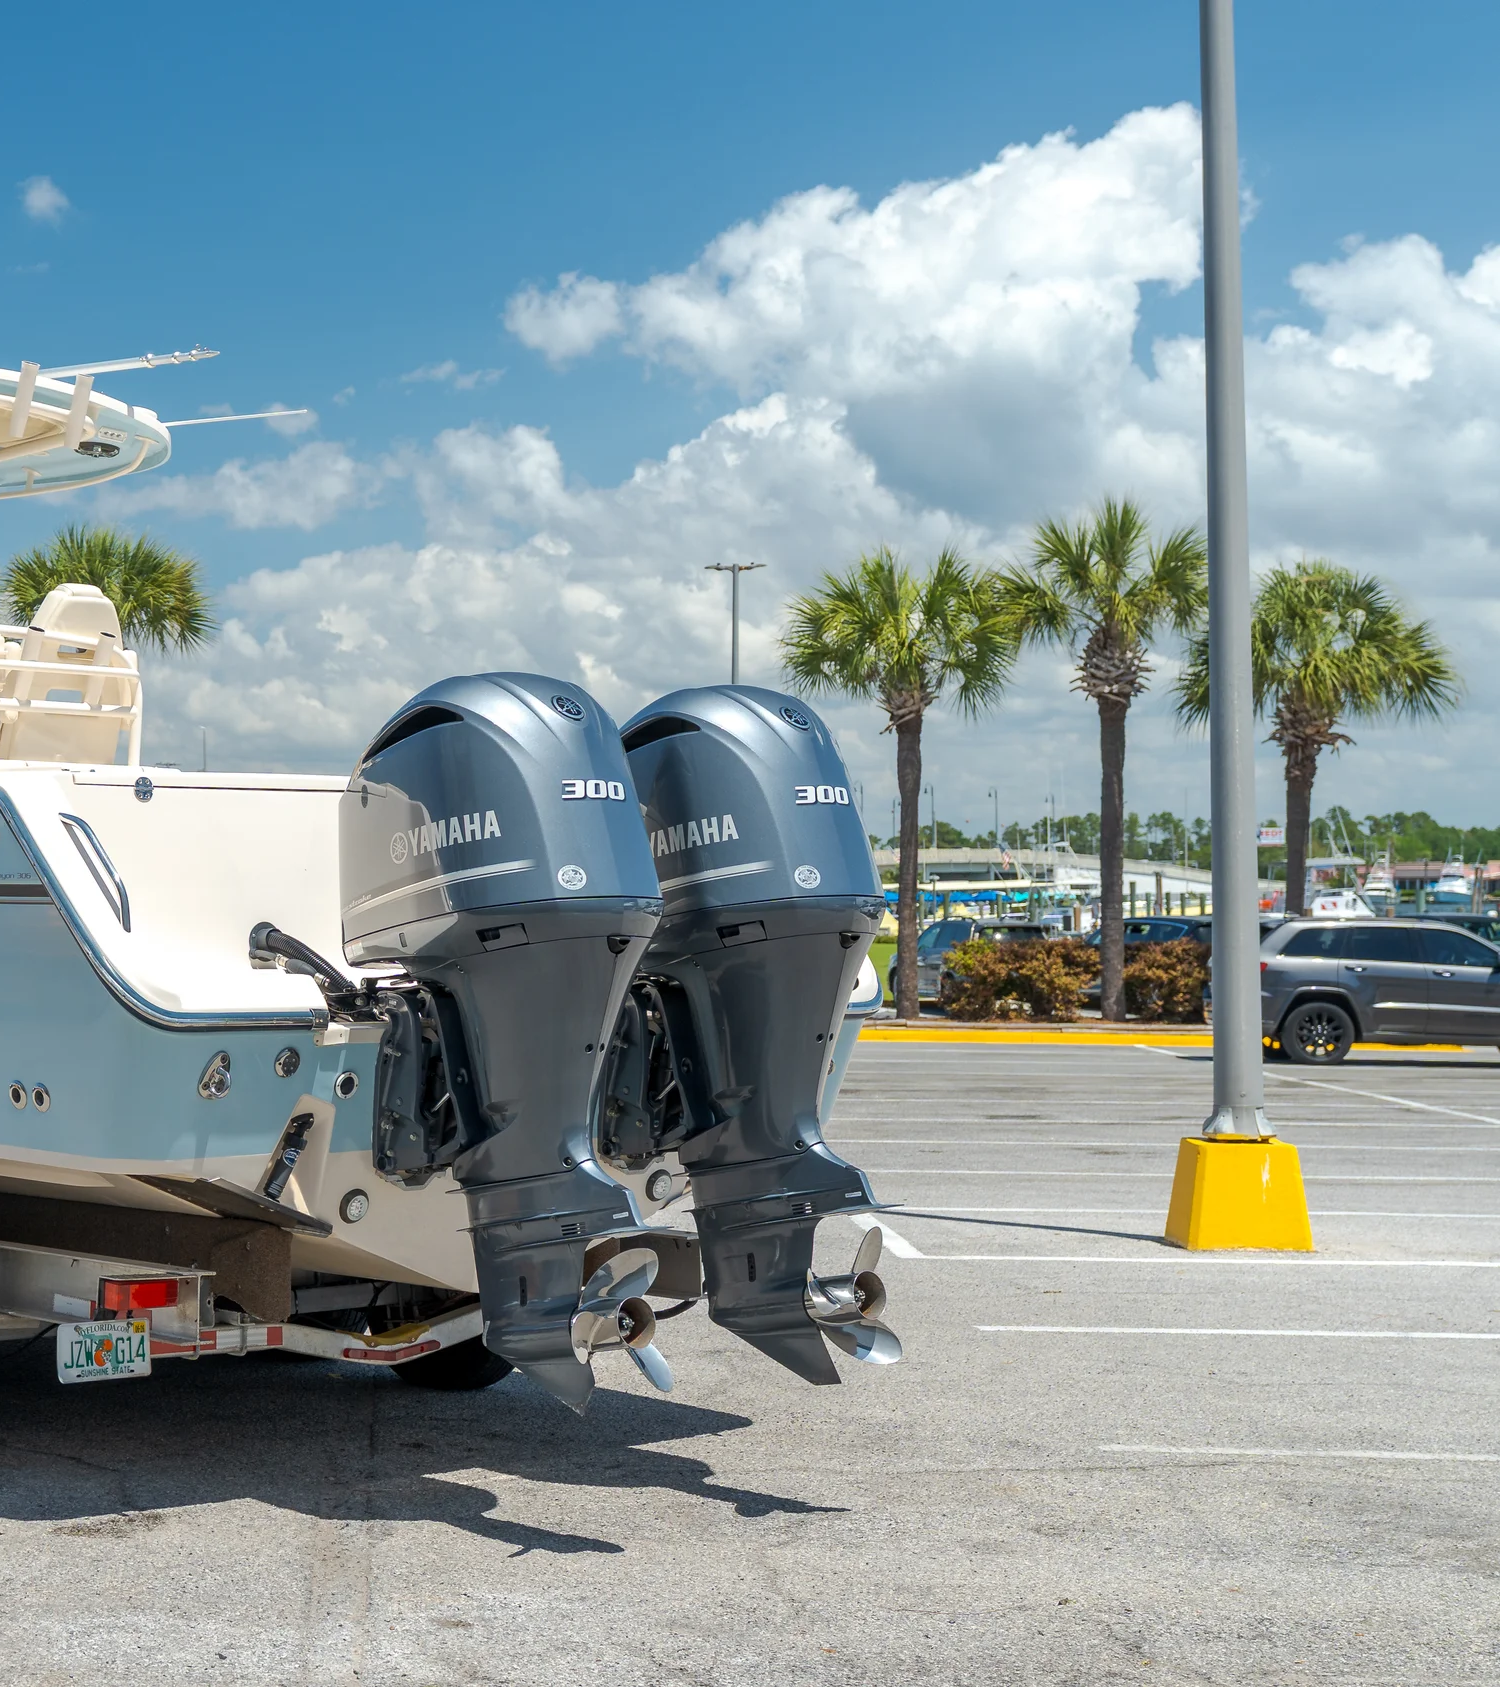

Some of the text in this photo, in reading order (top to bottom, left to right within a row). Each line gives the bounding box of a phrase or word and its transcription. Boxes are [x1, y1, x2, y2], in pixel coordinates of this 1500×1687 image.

[561, 779, 626, 801] 300
[794, 785, 850, 805] 300
[408, 810, 501, 856] YAMAHA
[650, 814, 739, 858] YAMAHA
[64, 1335, 145, 1369] JZW G14
[80, 1366, 131, 1378] SUNSHINE STATE
